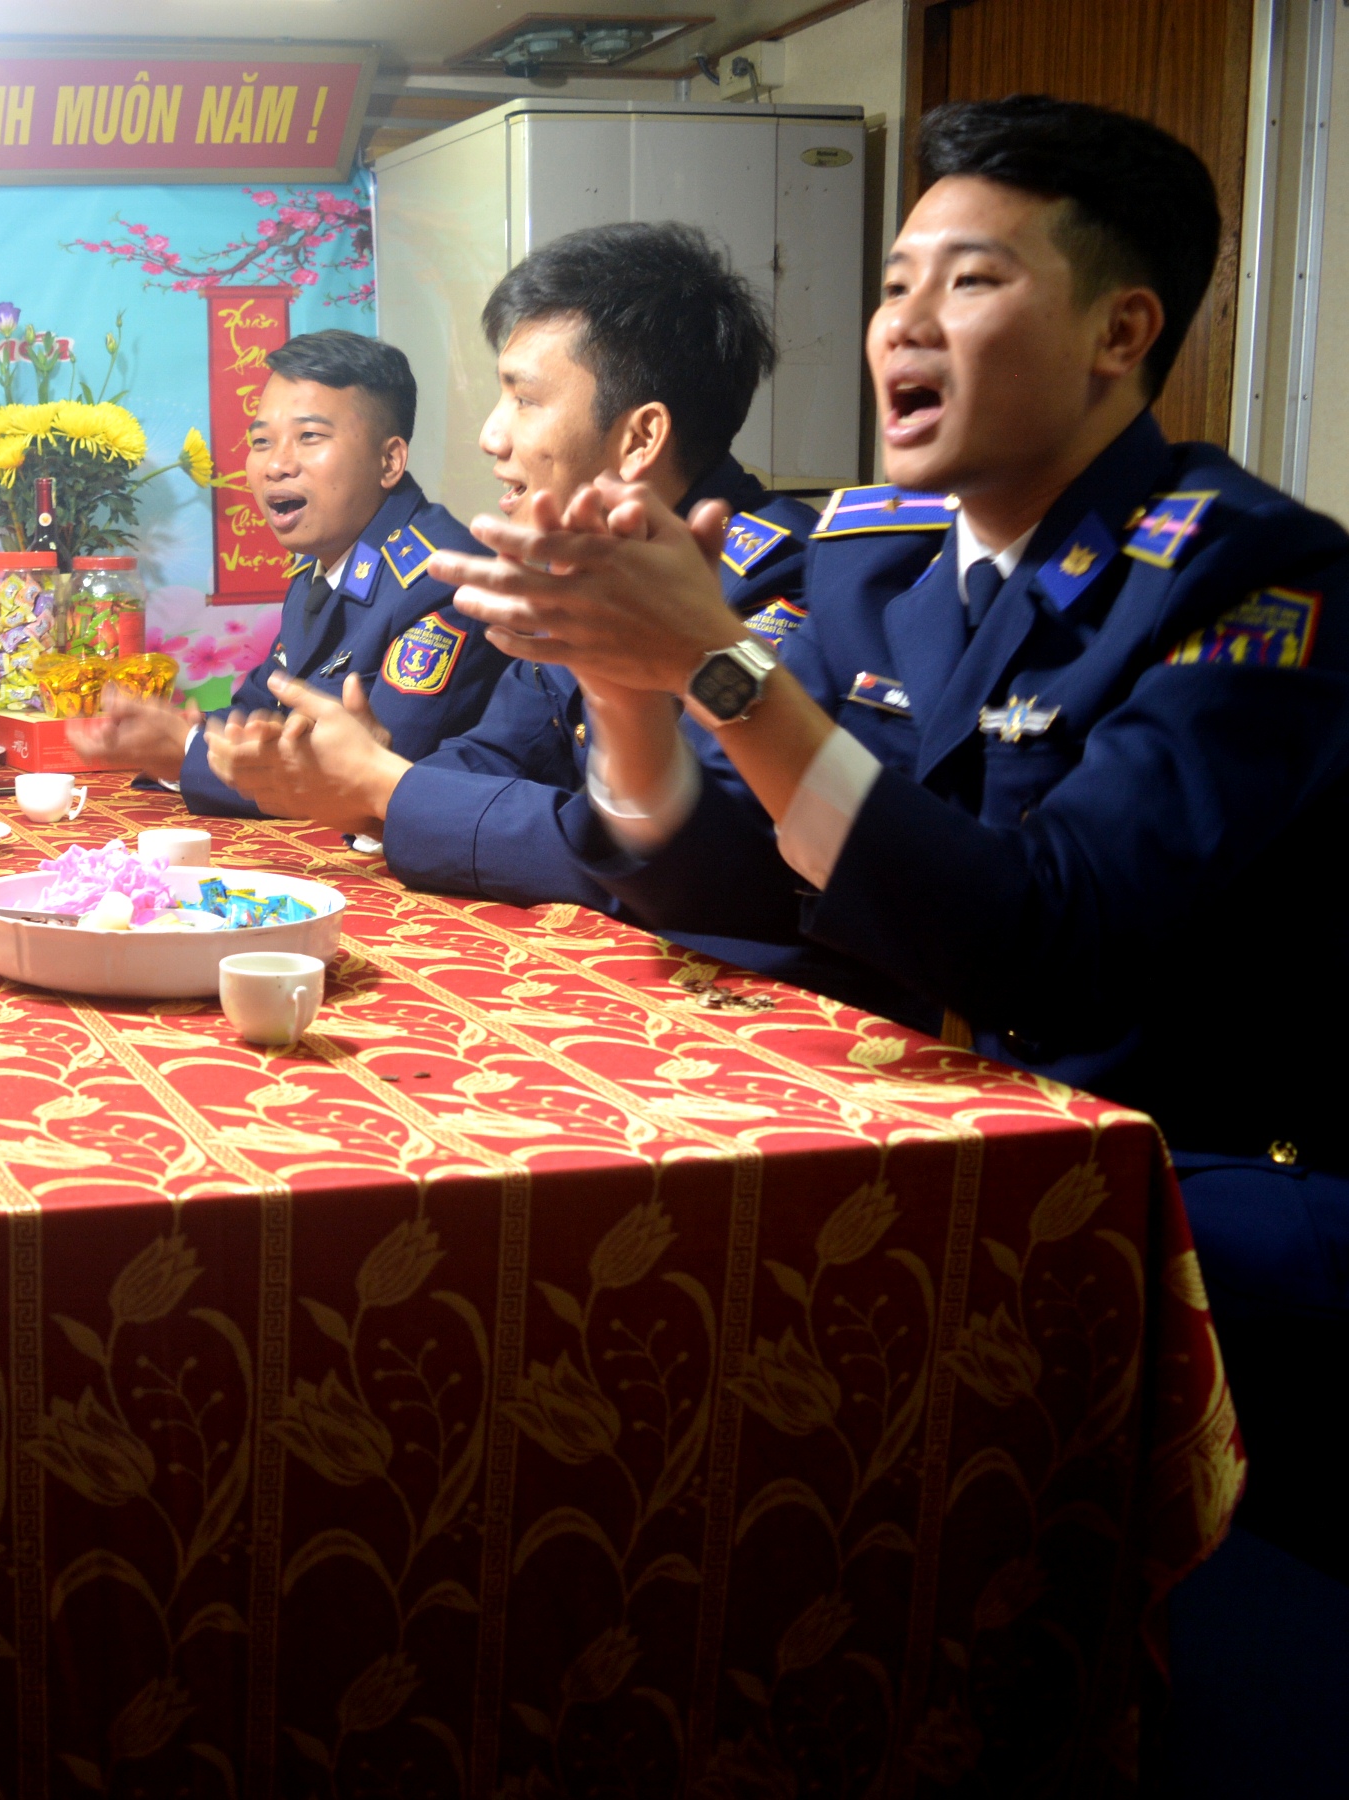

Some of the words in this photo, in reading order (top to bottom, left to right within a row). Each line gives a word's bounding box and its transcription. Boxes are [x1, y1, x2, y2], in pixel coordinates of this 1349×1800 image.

[51, 71, 183, 146] MUÔN
[195, 71, 298, 144] NĂM
[306, 86, 328, 144] !
